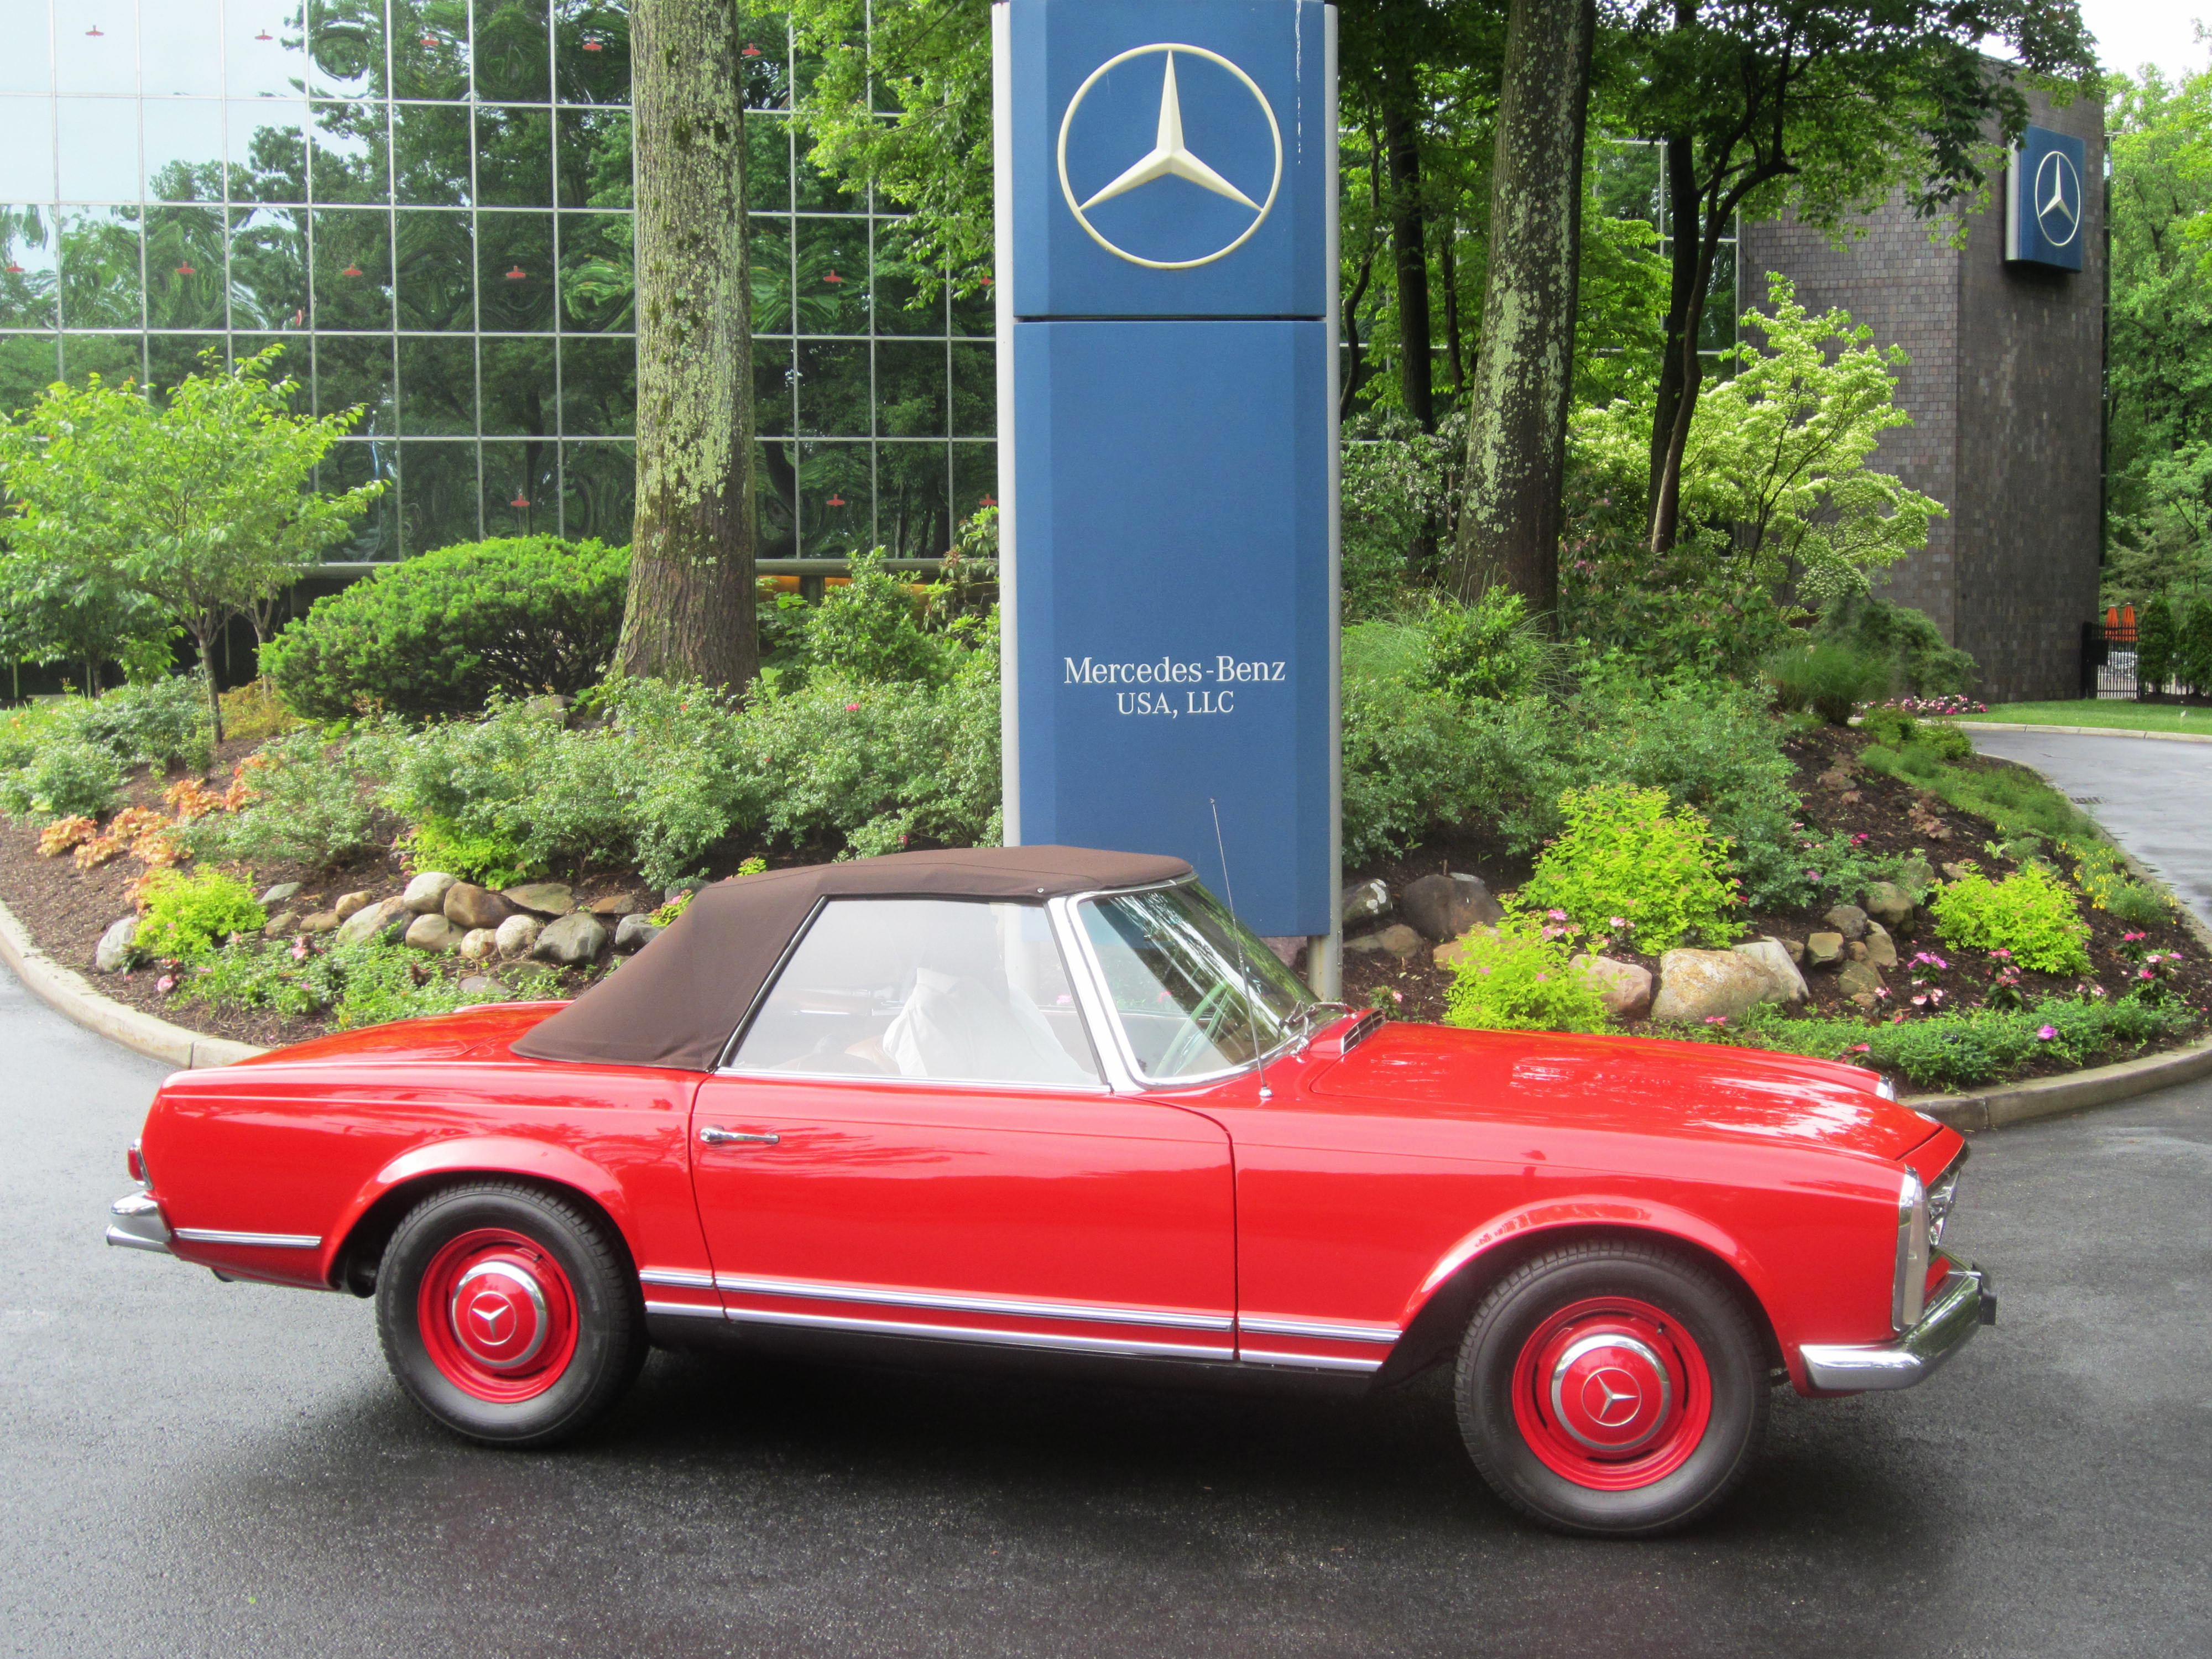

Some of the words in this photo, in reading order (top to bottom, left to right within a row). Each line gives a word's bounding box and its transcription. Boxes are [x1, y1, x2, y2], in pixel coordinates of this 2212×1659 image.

[1063, 656, 1286, 684] Mercedes-Benz
[1117, 691, 1178, 718] USA,
[1186, 690, 1234, 713] LLC
